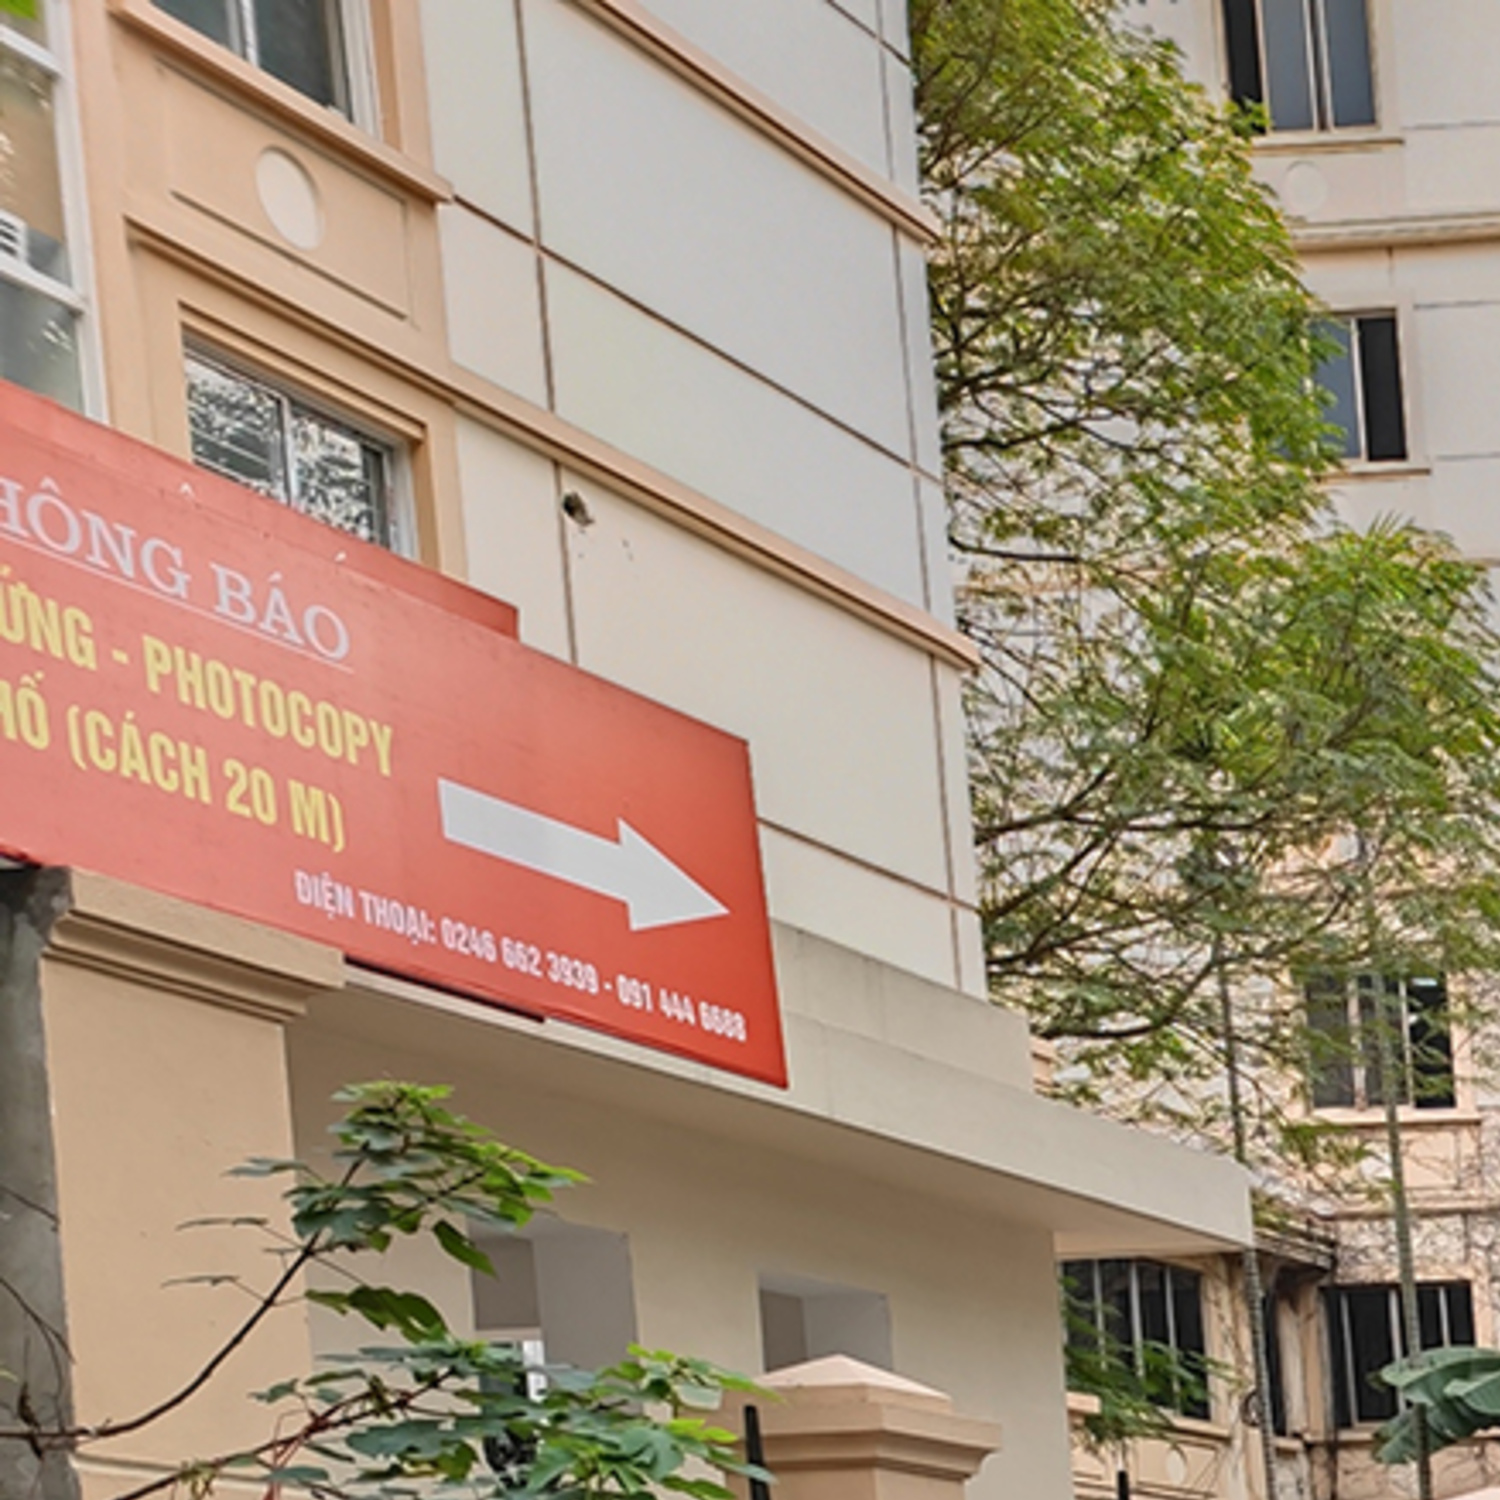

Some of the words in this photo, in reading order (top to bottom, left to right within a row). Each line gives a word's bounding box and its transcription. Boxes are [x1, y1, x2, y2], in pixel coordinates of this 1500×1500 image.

[209, 561, 351, 662] BÁO
[142, 632, 393, 777] PHOTOCOPY
[67, 704, 210, 803] (CÁCH
[224, 765, 277, 826] 20
[290, 780, 346, 853] M)
[294, 870, 354, 919] ĐIỆN
[359, 890, 436, 945] THOẠI:
[440, 917, 497, 963] 0246
[500, 936, 543, 977] 662
[546, 951, 600, 995] 3939
[617, 974, 653, 1011] 091
[659, 988, 696, 1026] 444
